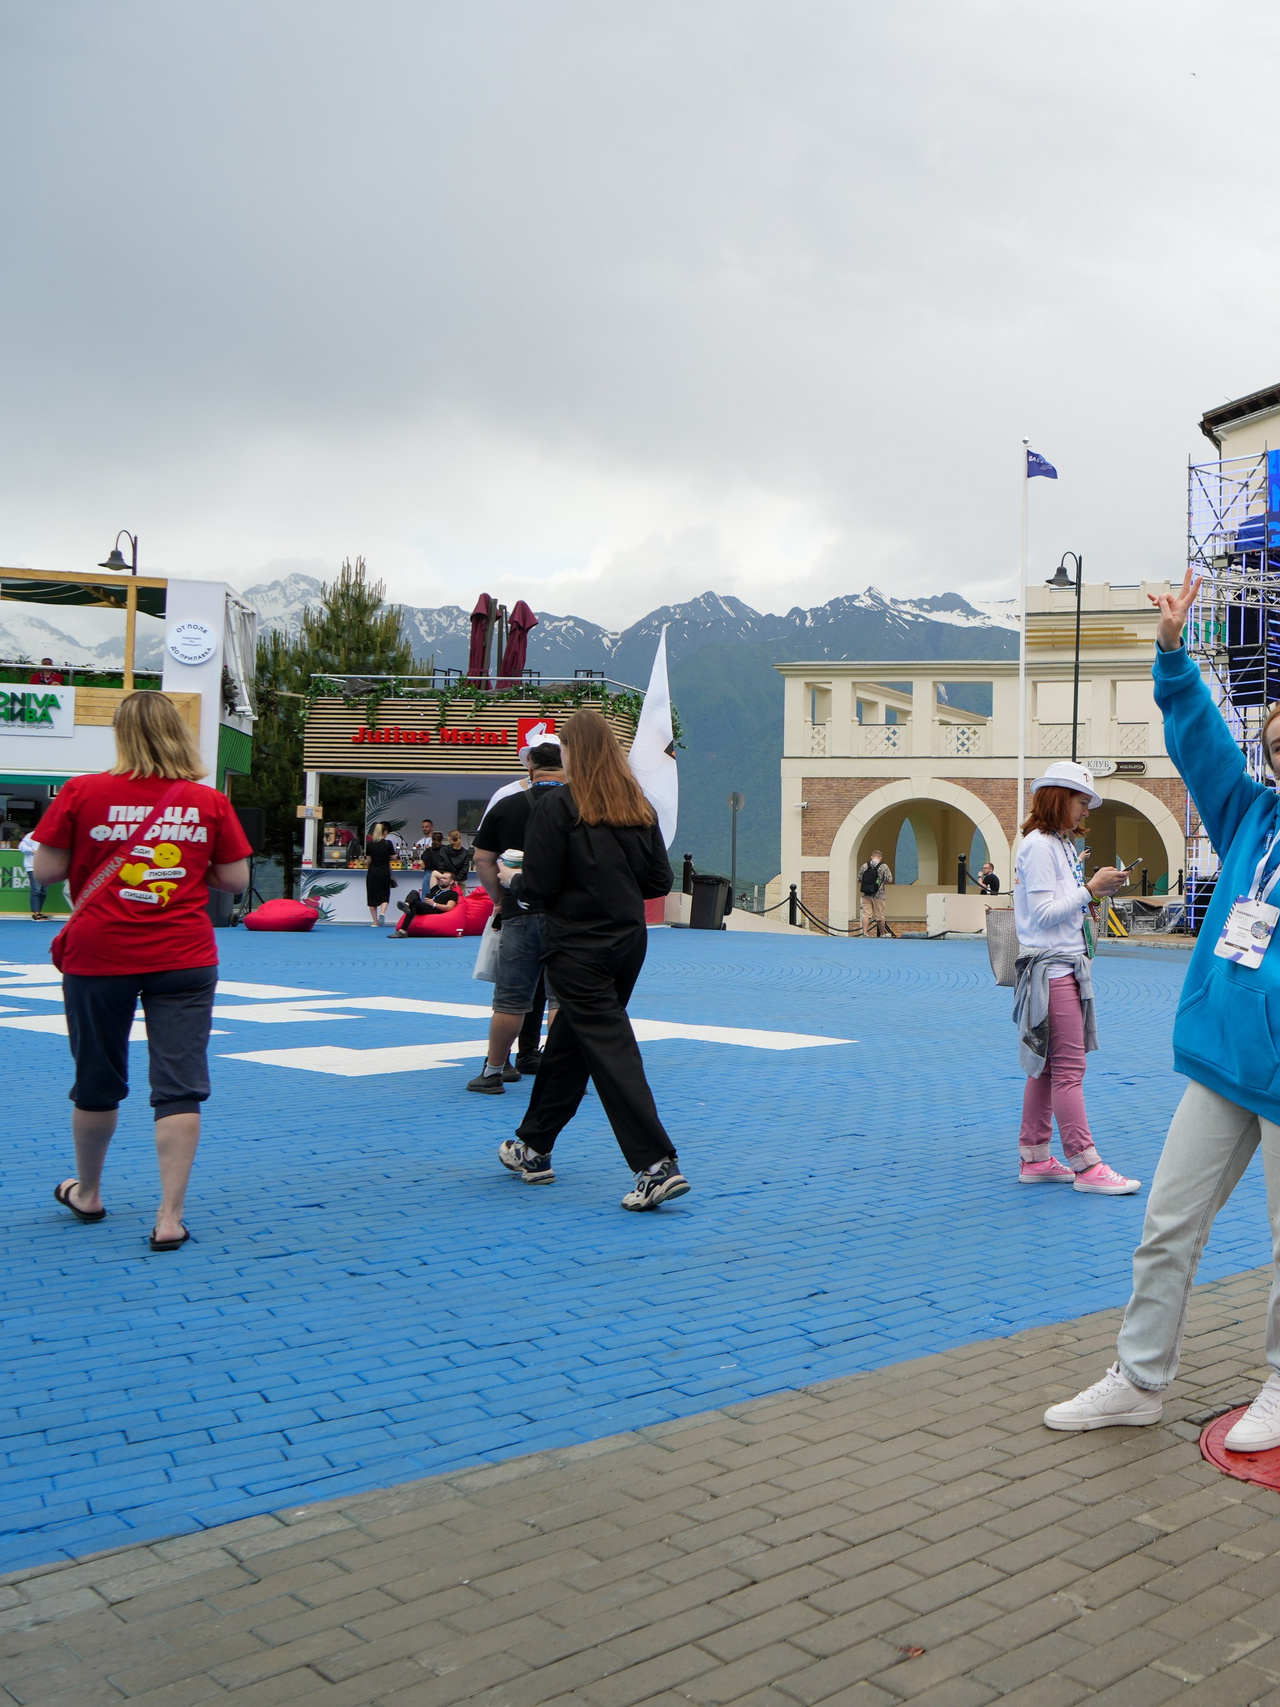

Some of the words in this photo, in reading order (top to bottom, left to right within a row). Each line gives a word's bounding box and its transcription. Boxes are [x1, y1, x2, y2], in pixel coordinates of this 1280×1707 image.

[351, 726, 430, 743] Julius
[439, 727, 509, 744] Meinl
[1087, 760, 1110, 768] КЛУБ
[81, 856, 126, 900] ФАБРИКА
[148, 869, 183, 877] ЛЮБОВЬ
[124, 890, 154, 900] ПИЦЦА
